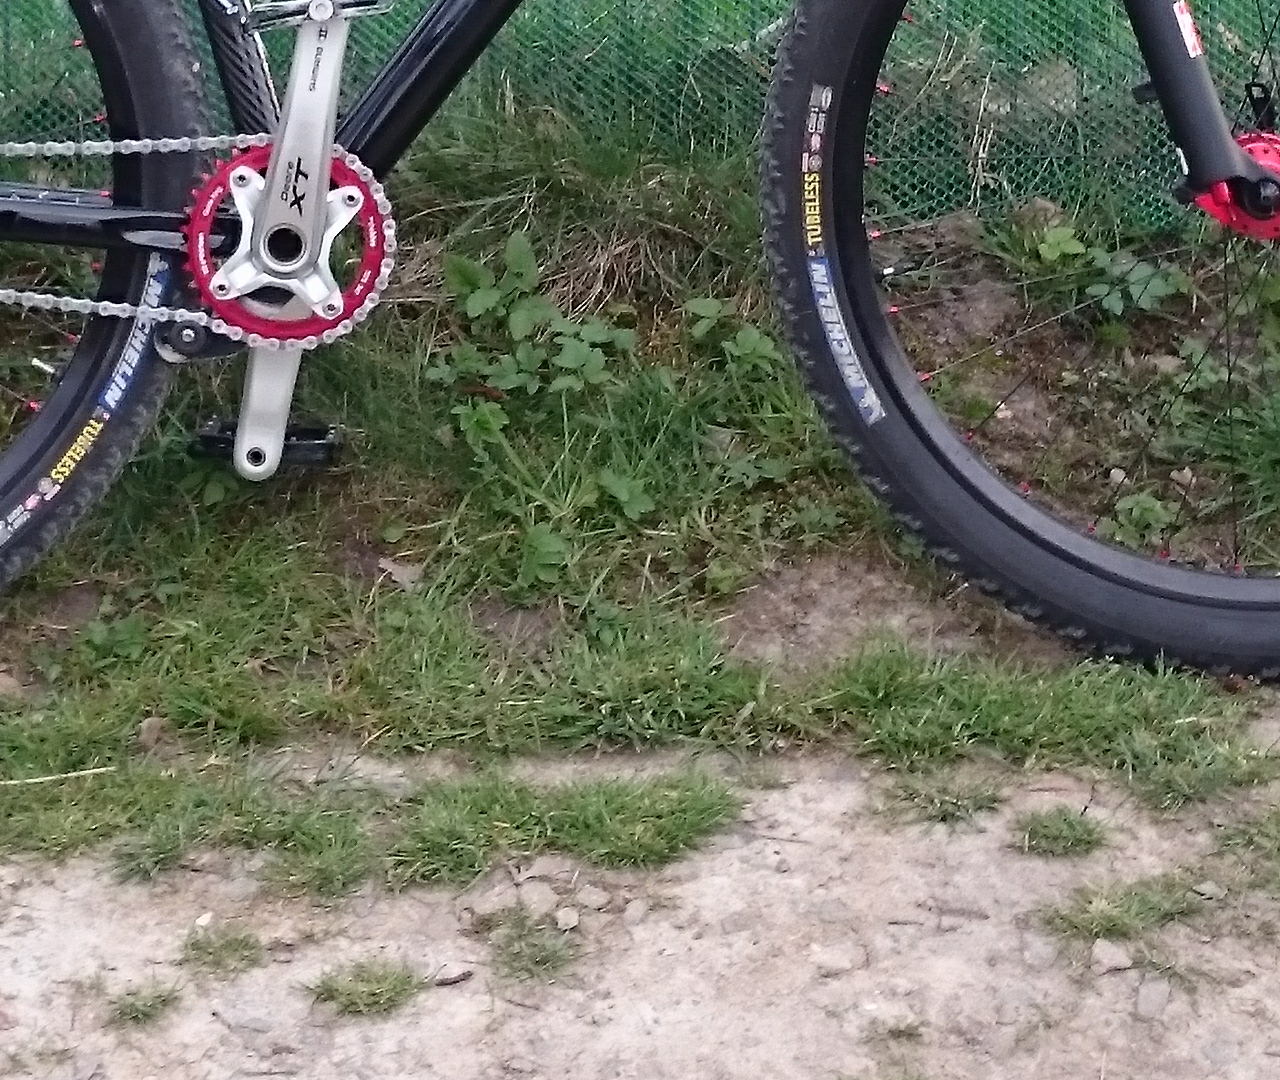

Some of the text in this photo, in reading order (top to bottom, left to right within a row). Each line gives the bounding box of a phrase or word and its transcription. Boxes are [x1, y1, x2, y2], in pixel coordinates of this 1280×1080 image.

[289, 156, 309, 218] XT
[804, 172, 823, 247] TUBELESS
[810, 262, 867, 388] MICHELIN
[51, 277, 163, 483] MCHELIN TUBELESS
